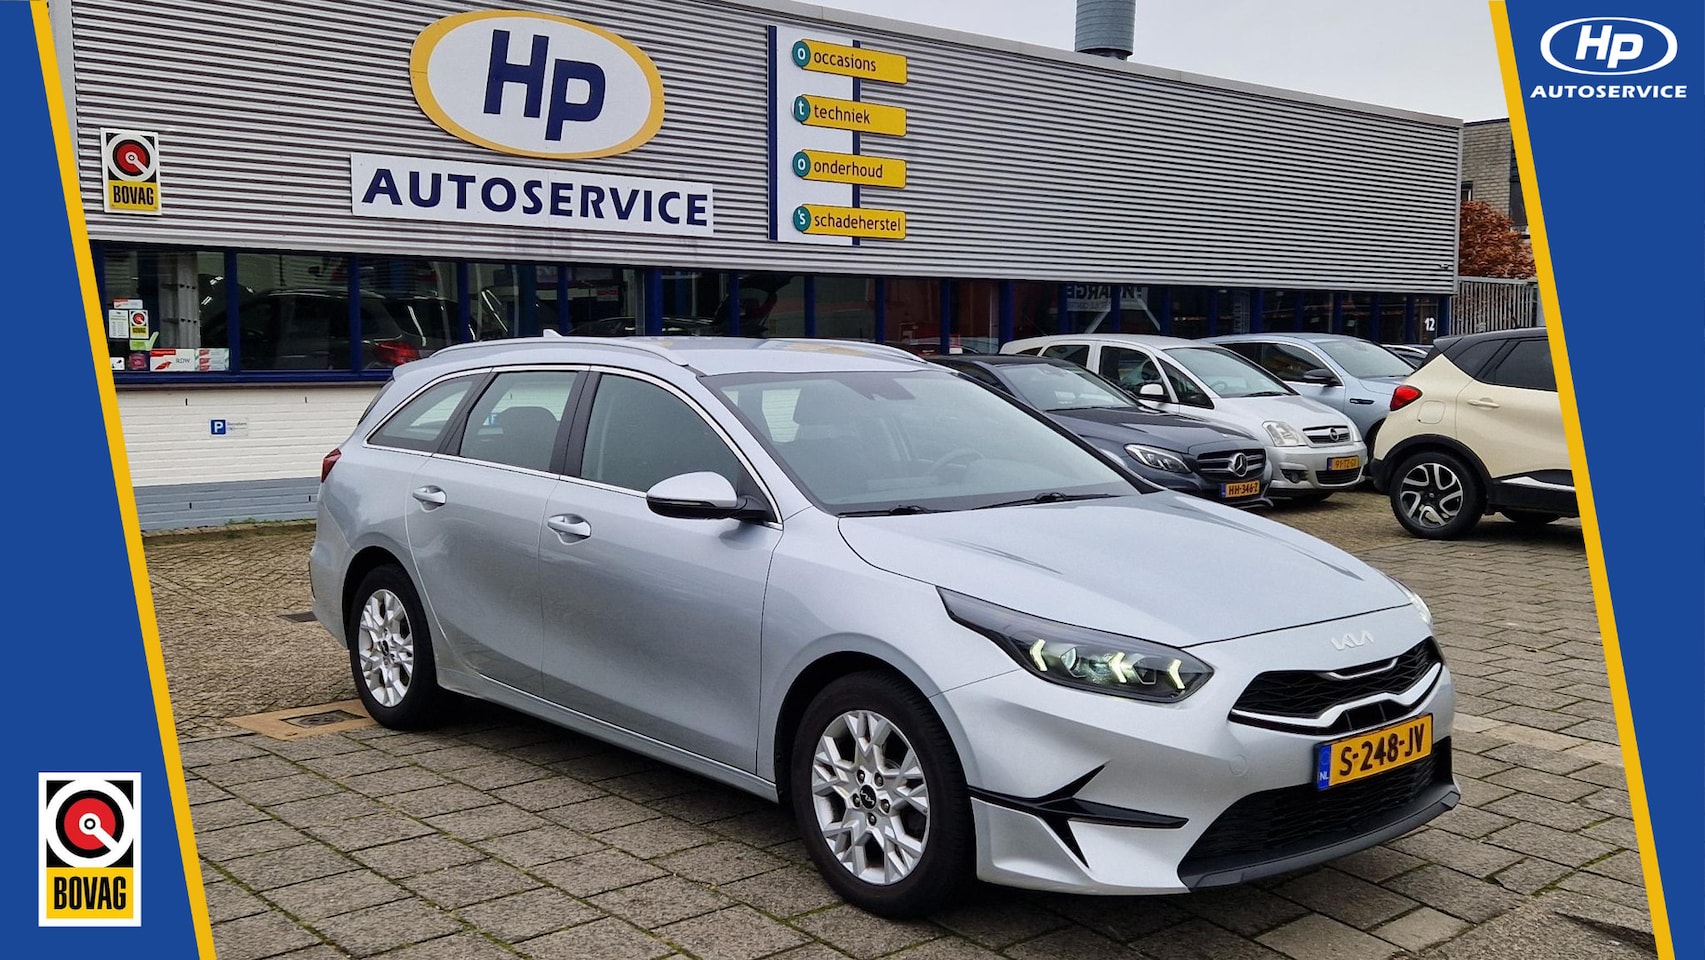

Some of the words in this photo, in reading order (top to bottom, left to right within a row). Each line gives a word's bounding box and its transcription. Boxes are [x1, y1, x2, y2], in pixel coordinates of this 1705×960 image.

[814, 50, 876, 72] occasions
[814, 103, 870, 124] techniek
[814, 160, 883, 178] onderhoud
[113, 185, 154, 206] BOVAG
[362, 168, 708, 226] AUTOSERVICE
[814, 212, 901, 232] schadeherstel
[1424, 317, 1435, 331] 12
[1319, 771, 1329, 781] NL
[1339, 723, 1425, 776] S-248-JV
